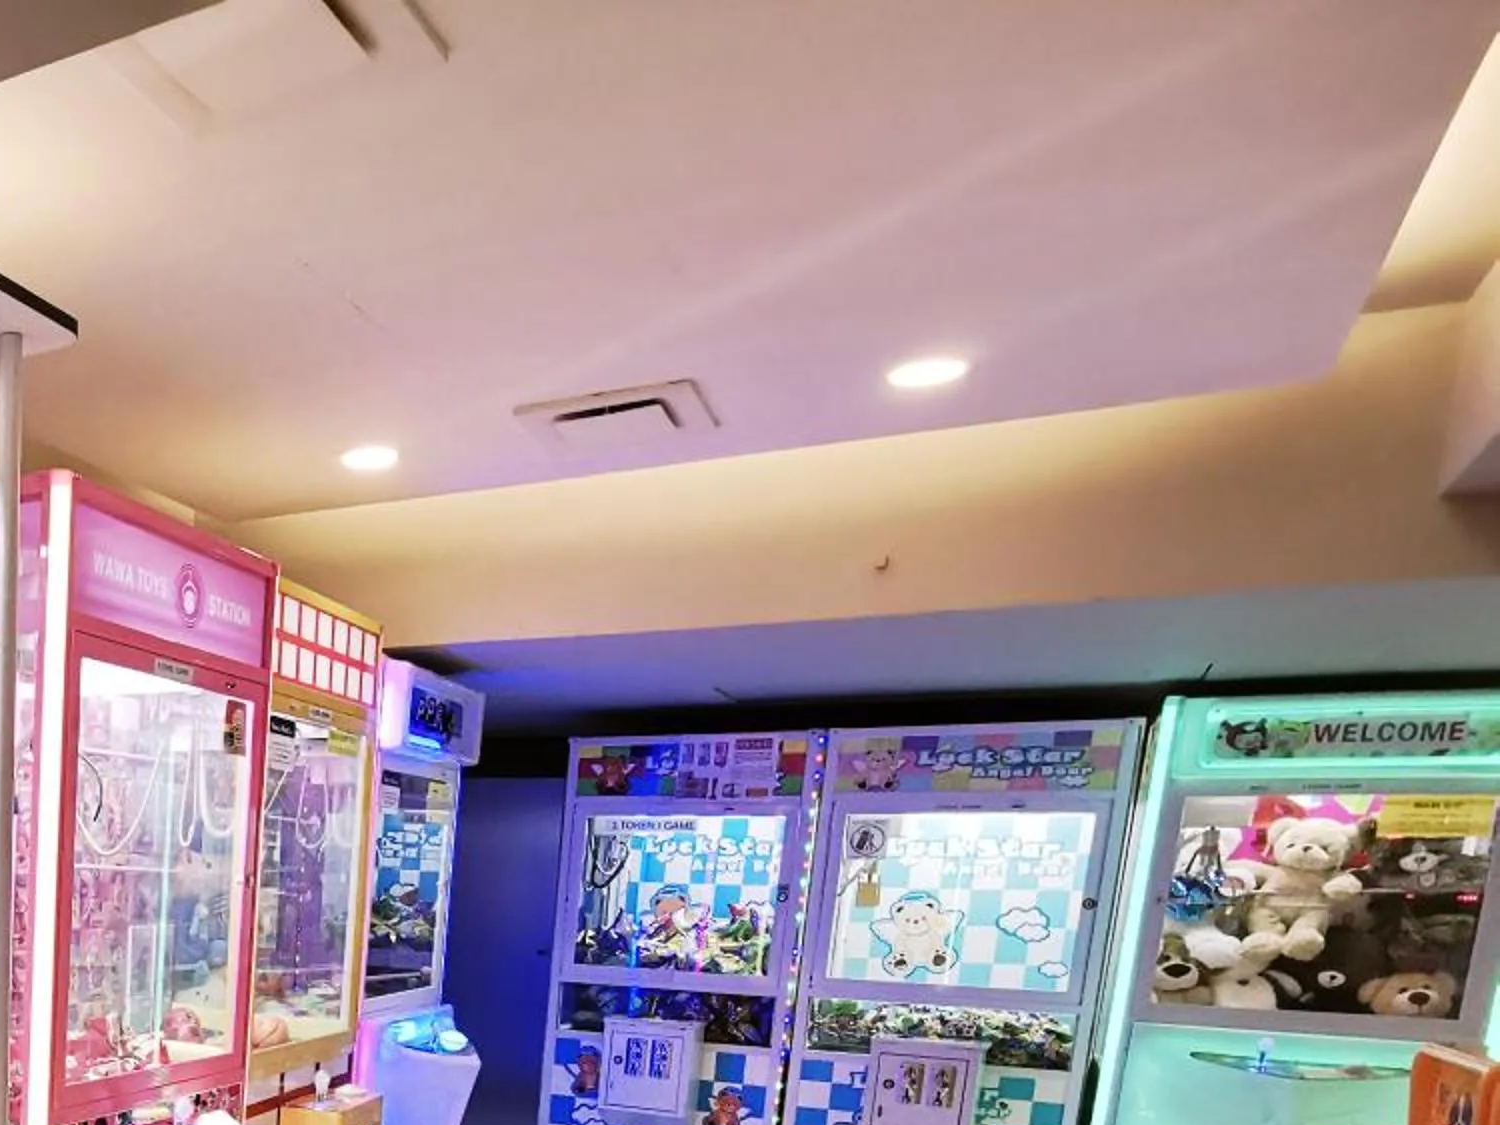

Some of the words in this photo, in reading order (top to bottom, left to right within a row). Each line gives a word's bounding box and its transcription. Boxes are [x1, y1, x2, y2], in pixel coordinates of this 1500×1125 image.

[93, 552, 135, 588] WAWA
[138, 569, 168, 599] TOYS
[208, 594, 252, 627] STATION
[1314, 720, 1466, 743] WELCOME
[1001, 746, 1084, 766] Star
[664, 820, 695, 831] GAME
